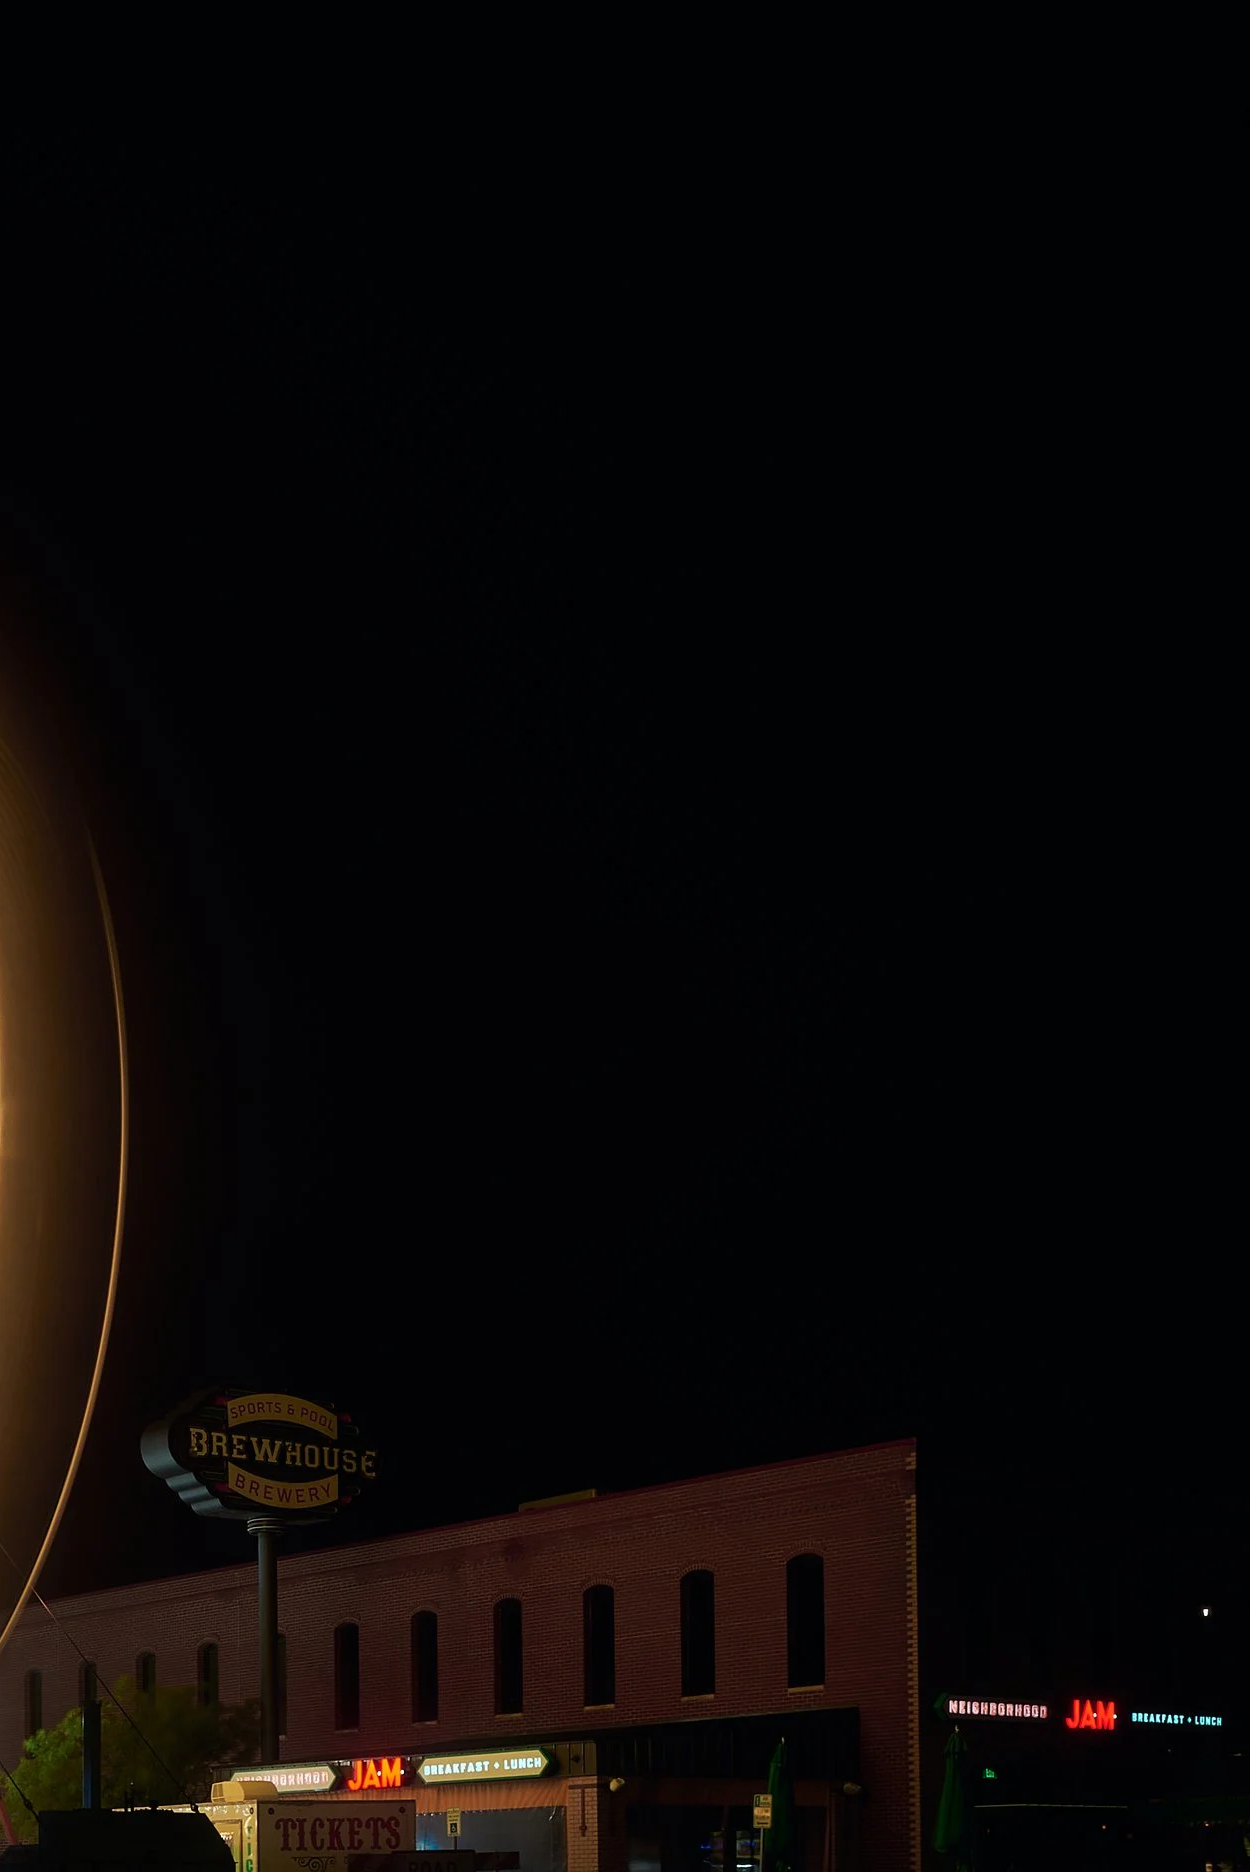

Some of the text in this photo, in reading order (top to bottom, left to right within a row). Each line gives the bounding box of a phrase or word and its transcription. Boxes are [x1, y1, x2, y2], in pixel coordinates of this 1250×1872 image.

[230, 1401, 336, 1432] SPORTS & POOL
[189, 1426, 377, 1479] BREWHOUSE
[235, 1473, 332, 1504] BREWERY
[949, 1700, 1048, 1719] NEIGHBORHOOD
[1065, 1699, 1115, 1730] JAM
[1131, 1712, 1223, 1726] BREAKFAST LUNCH
[348, 1756, 402, 1791] JAM
[423, 1757, 542, 1776] BREAKFAST LUNCH
[275, 1815, 401, 1852] TICKETS
